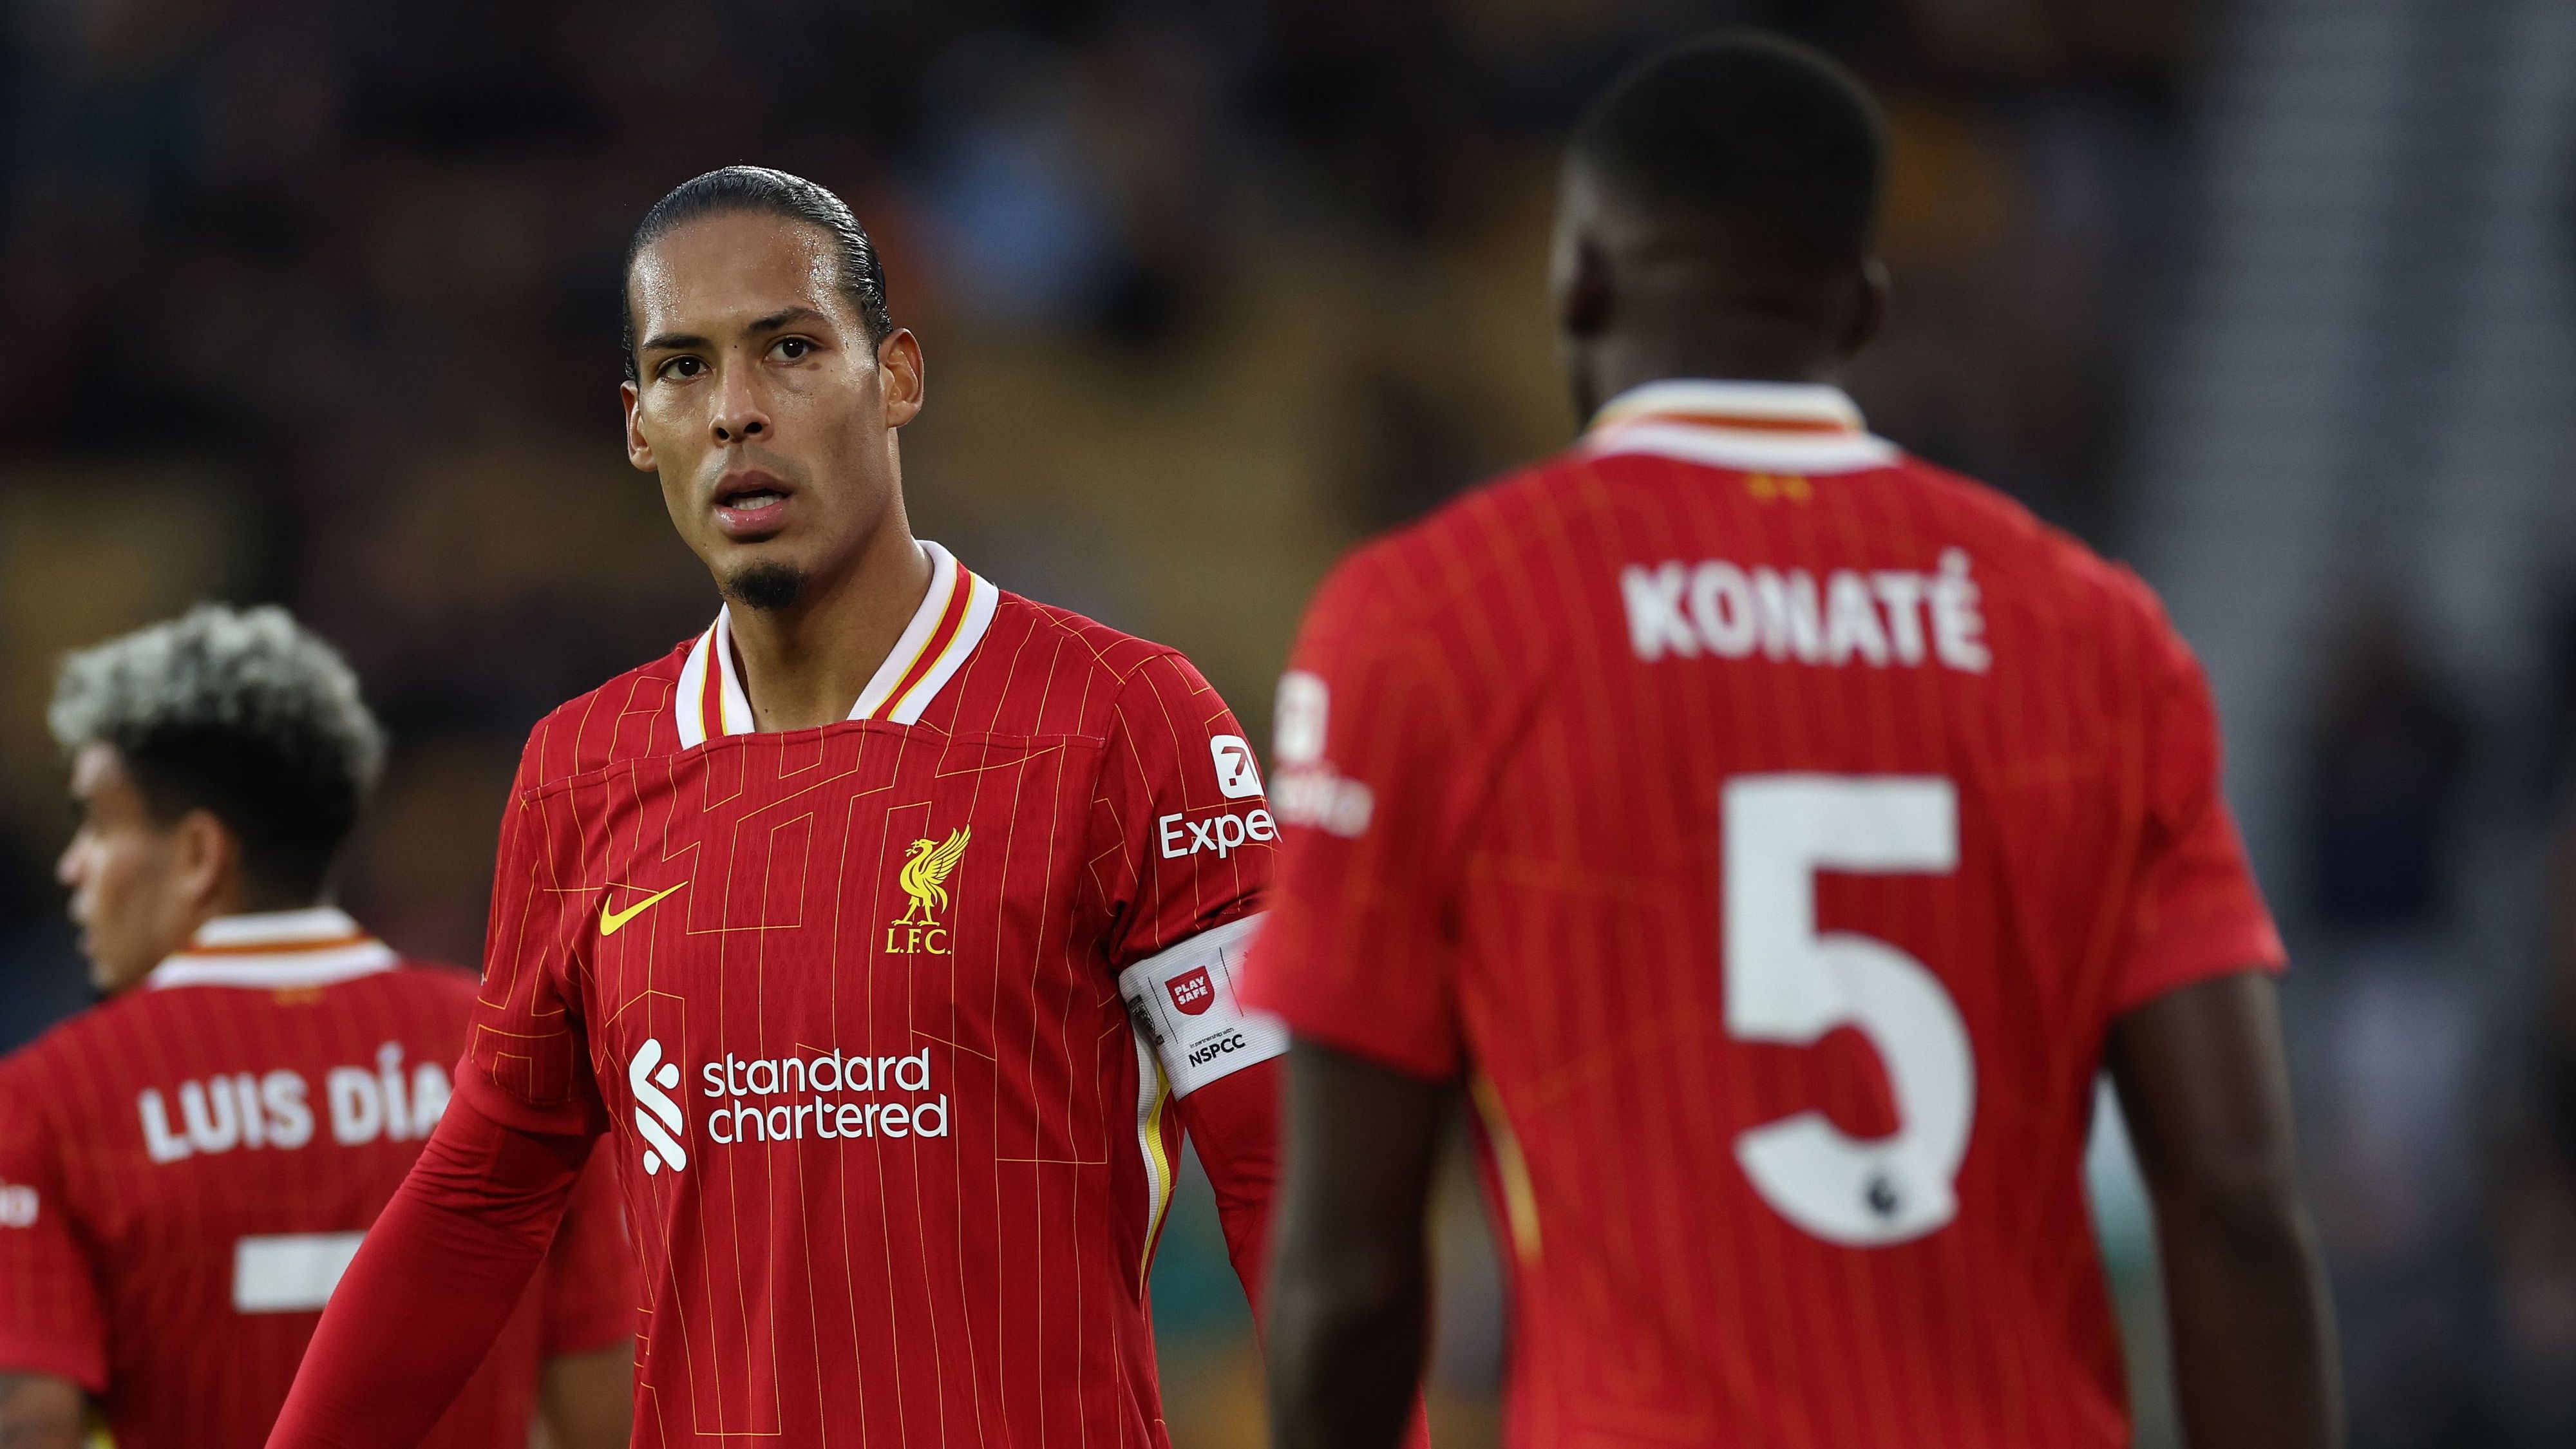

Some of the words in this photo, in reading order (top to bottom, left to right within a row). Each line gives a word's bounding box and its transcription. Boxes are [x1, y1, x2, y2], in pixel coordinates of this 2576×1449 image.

[1621, 548, 1991, 674] KONATÉ
[1159, 808, 1282, 858] Expe
[885, 928, 952, 955] L.F.C.
[1174, 976, 1204, 996] PLAY
[1178, 986, 1208, 1005] SAFE
[1721, 777, 1976, 1247] 5
[1188, 1034, 1245, 1068] NSPCC
[1195, 1032, 1222, 1047] partnership
[704, 1046, 930, 1096] standard
[137, 1070, 314, 1164] LUIS
[708, 1094, 948, 1144] chartered
